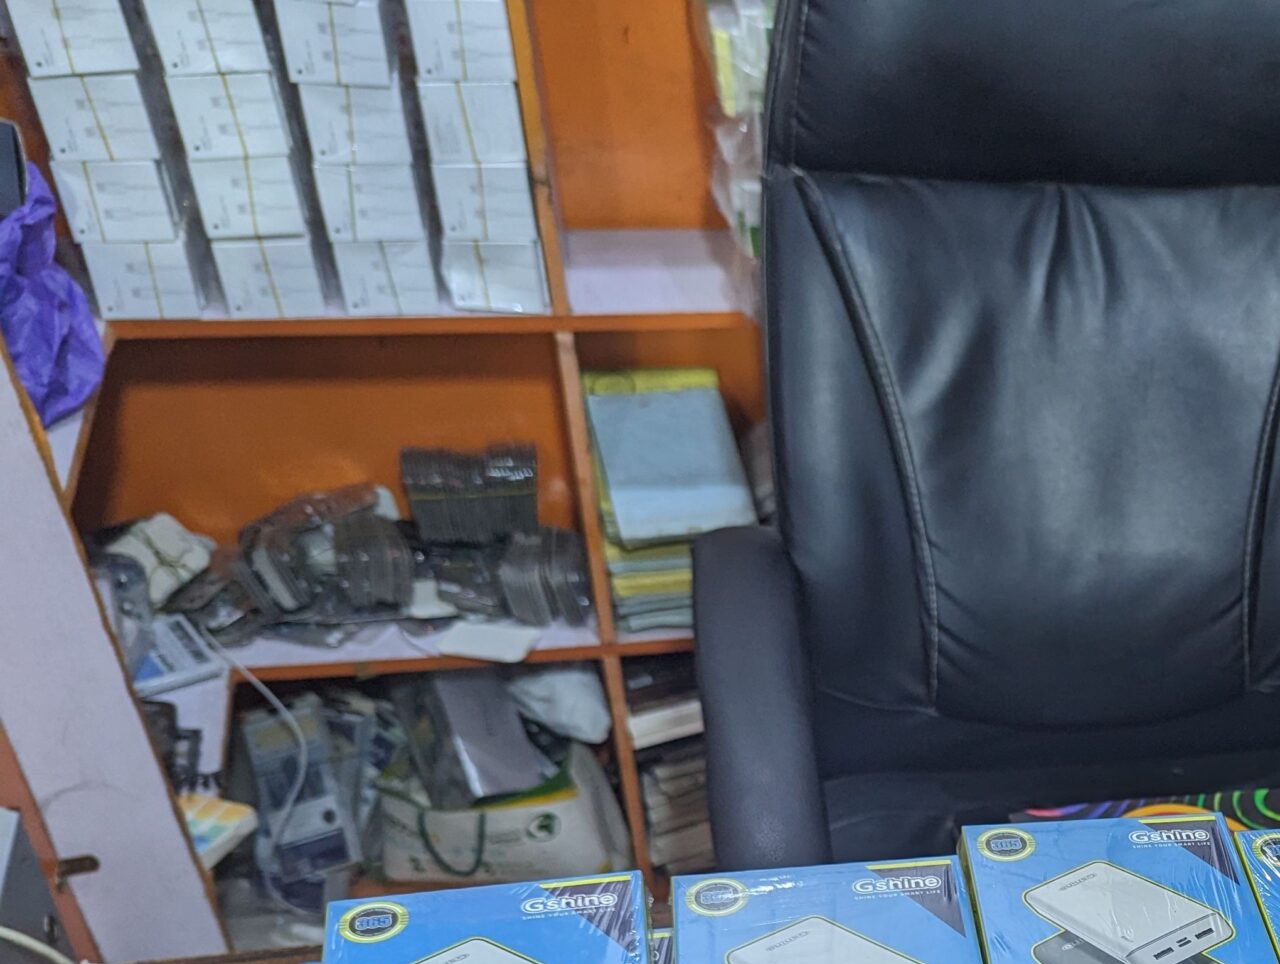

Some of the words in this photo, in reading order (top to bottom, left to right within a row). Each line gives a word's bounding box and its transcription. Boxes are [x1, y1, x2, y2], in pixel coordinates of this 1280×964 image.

[1129, 829, 1209, 843] Gshine
[852, 876, 941, 894] Gshine
[522, 893, 616, 912] Gshine
